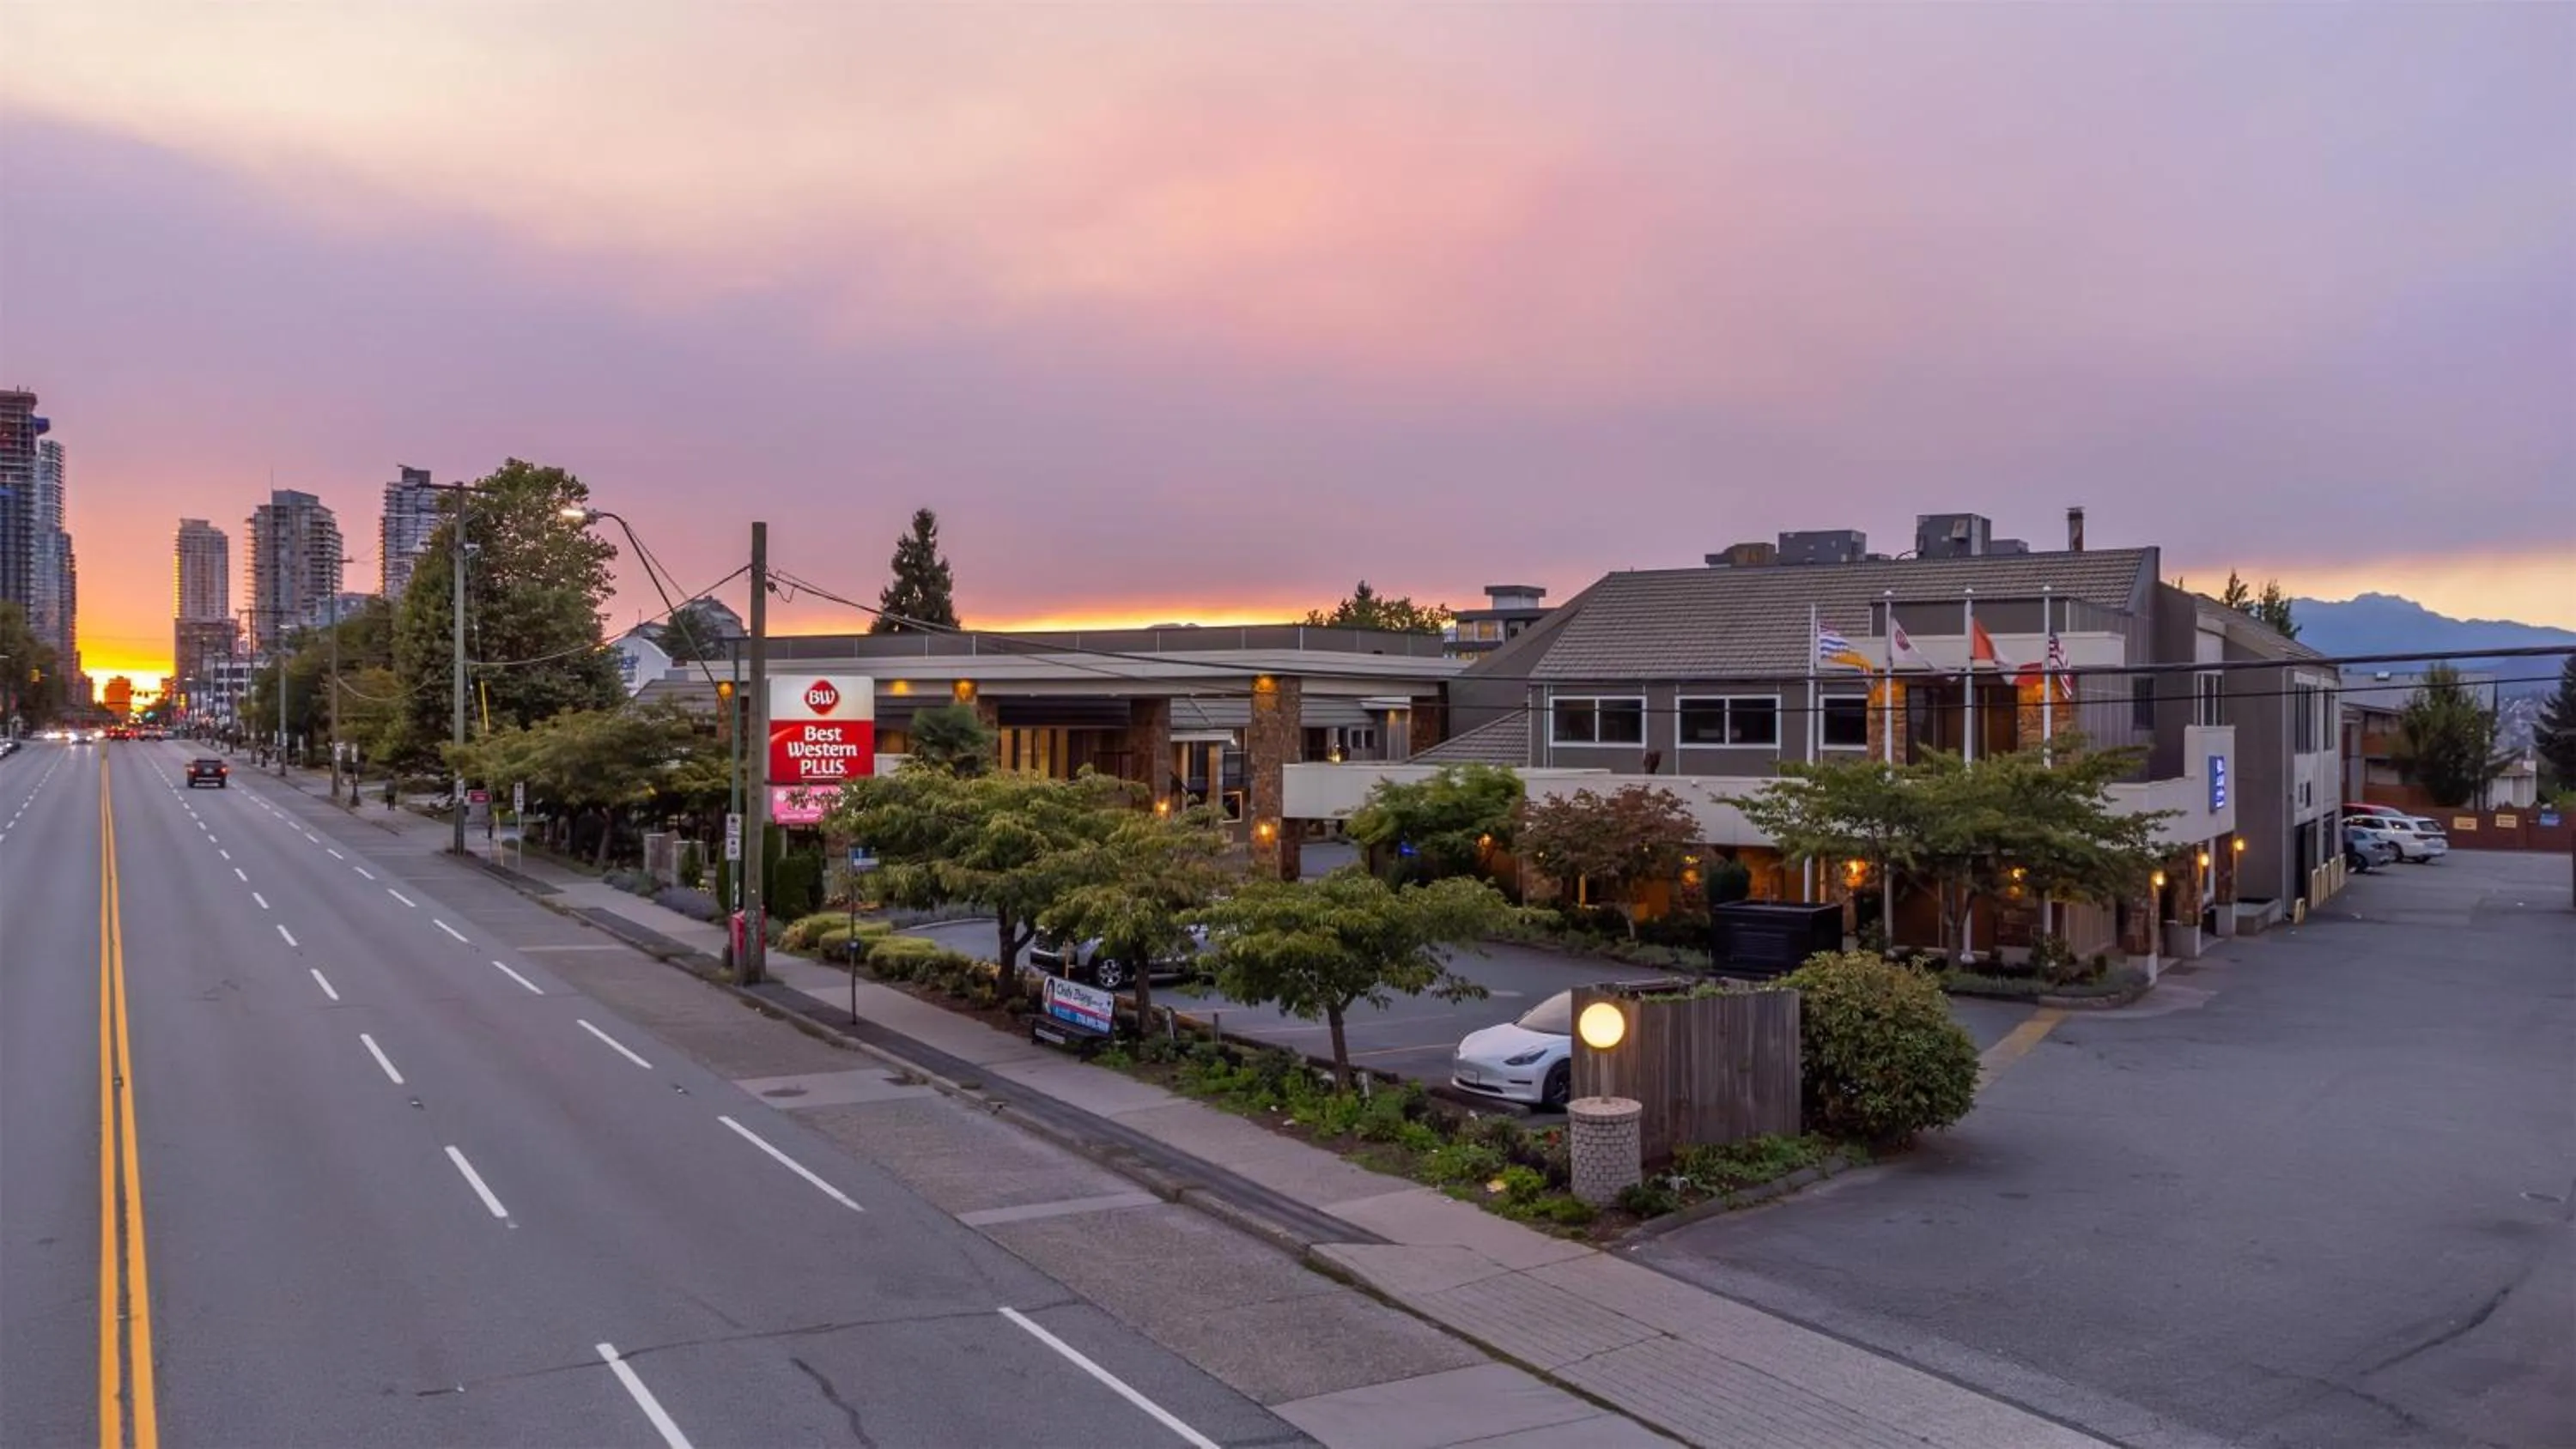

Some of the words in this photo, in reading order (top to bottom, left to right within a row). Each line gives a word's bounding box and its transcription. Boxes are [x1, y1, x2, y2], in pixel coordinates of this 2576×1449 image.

[808, 689, 835, 705] BW
[804, 725, 842, 742] Best
[787, 741, 858, 758] Western
